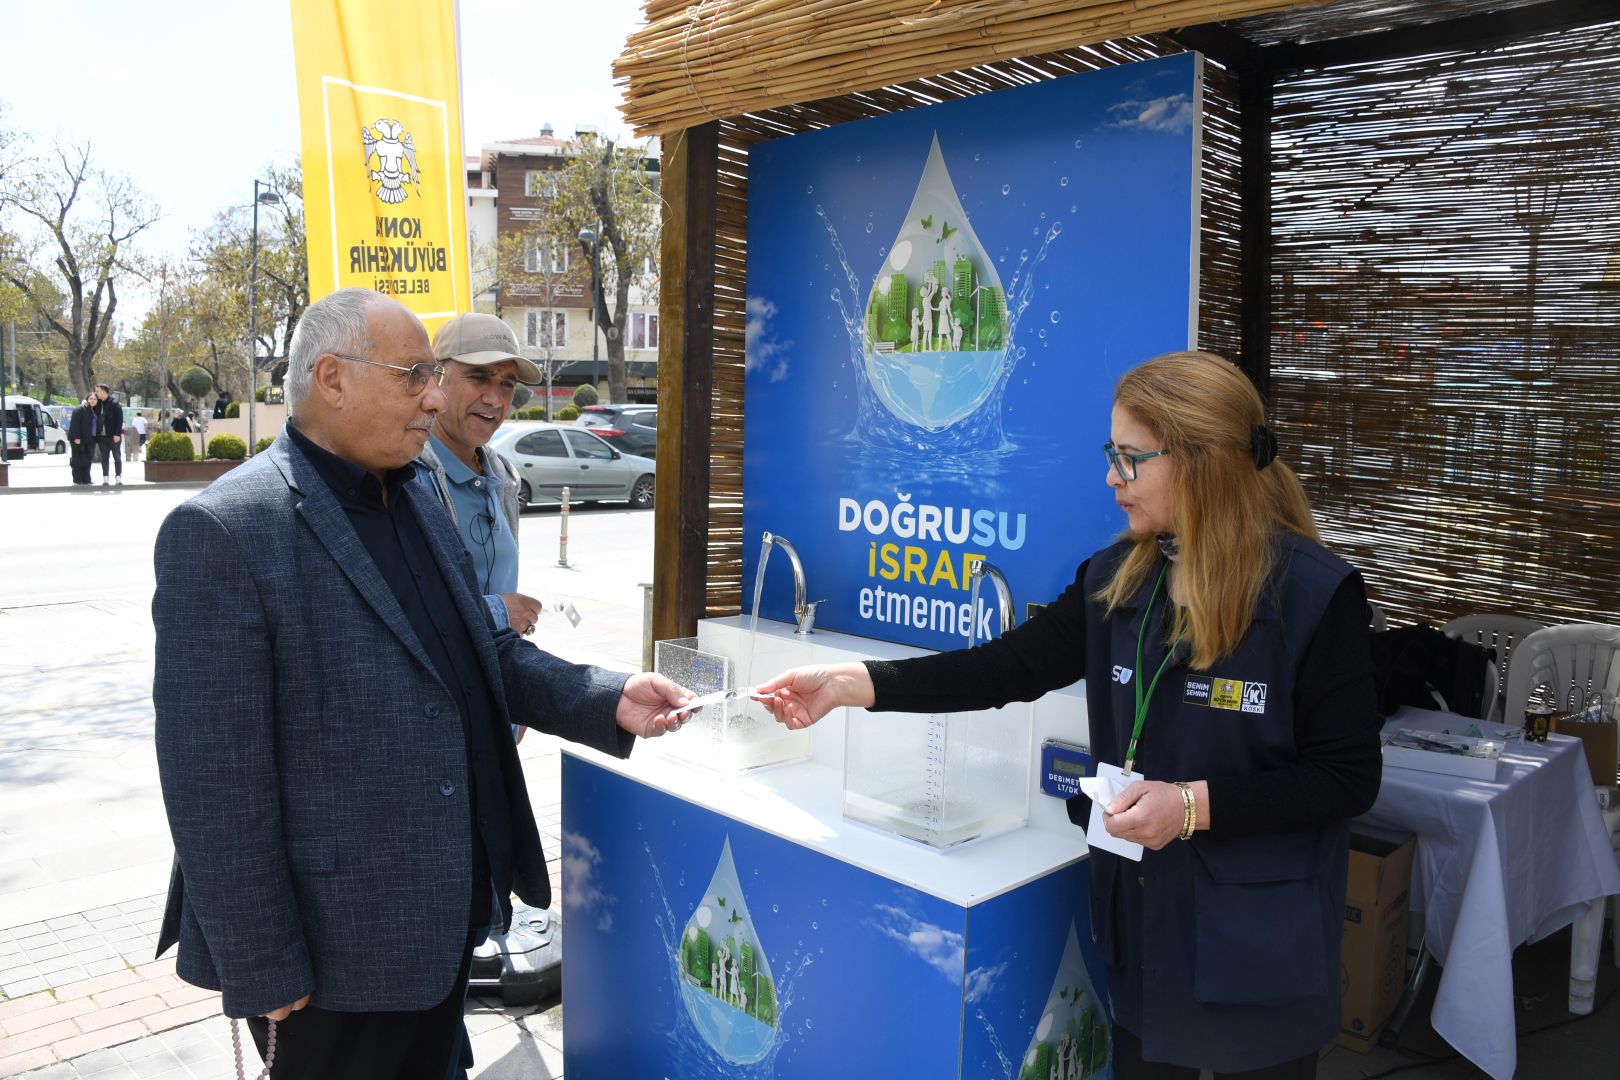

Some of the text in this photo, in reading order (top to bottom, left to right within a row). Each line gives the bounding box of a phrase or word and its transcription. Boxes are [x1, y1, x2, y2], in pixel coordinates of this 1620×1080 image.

[838, 492, 1027, 550] DOĞRUSU
[859, 585, 994, 641] etmemek
[1057, 783, 1079, 796] LT/DK
